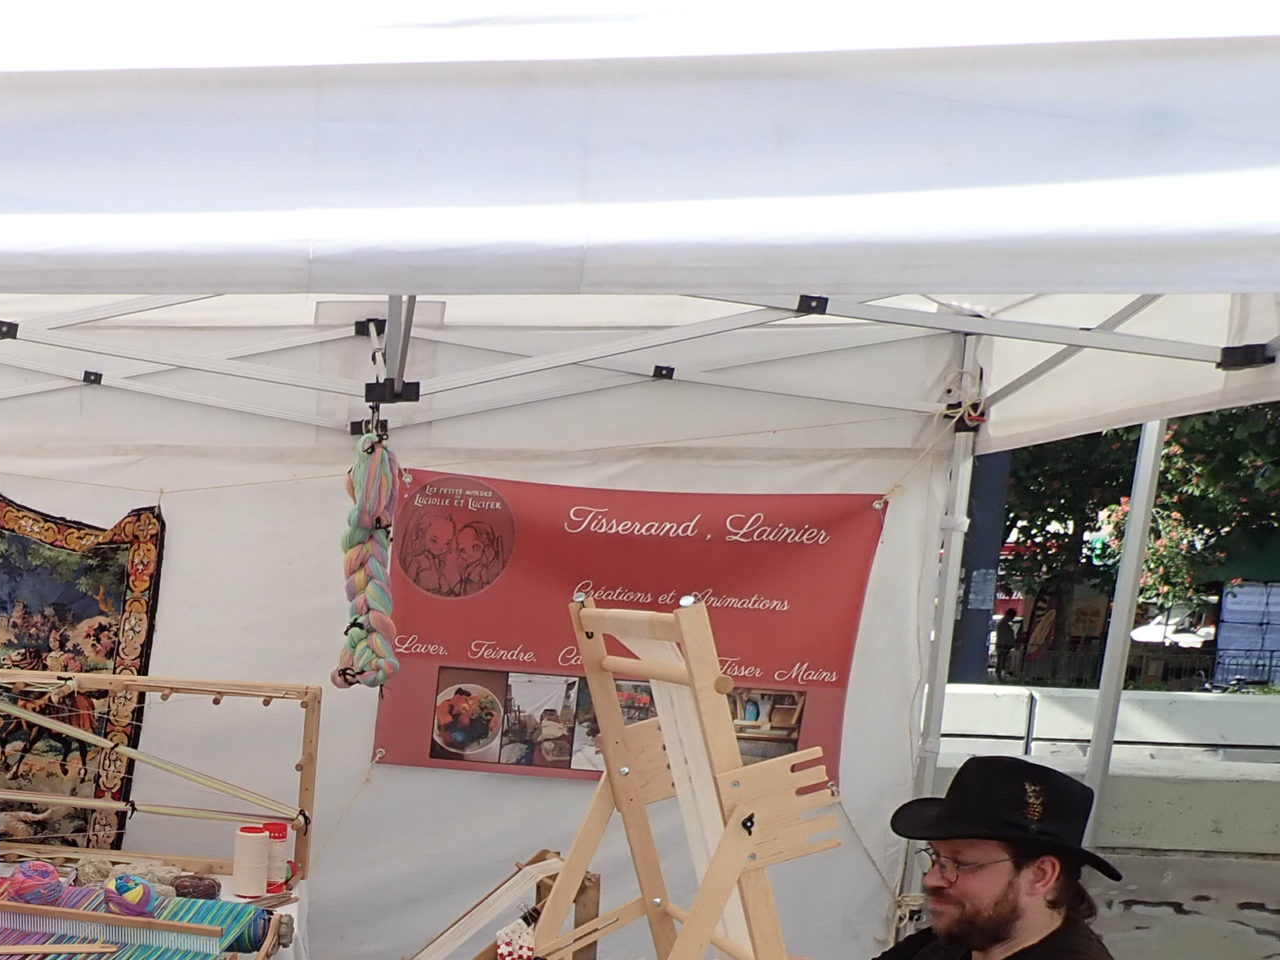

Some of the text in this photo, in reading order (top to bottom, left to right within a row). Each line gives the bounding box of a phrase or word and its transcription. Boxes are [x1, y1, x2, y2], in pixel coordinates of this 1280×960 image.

[454, 499, 464, 507] ET
[468, 498, 501, 511] LUCIFER
[564, 506, 702, 538] Tisserand
[725, 512, 831, 545] Lainier
[573, 580, 790, 611] Créations et Animations
[468, 640, 536, 662] Teindre.
[718, 657, 763, 677] Tisser
[774, 662, 839, 685] Mains
